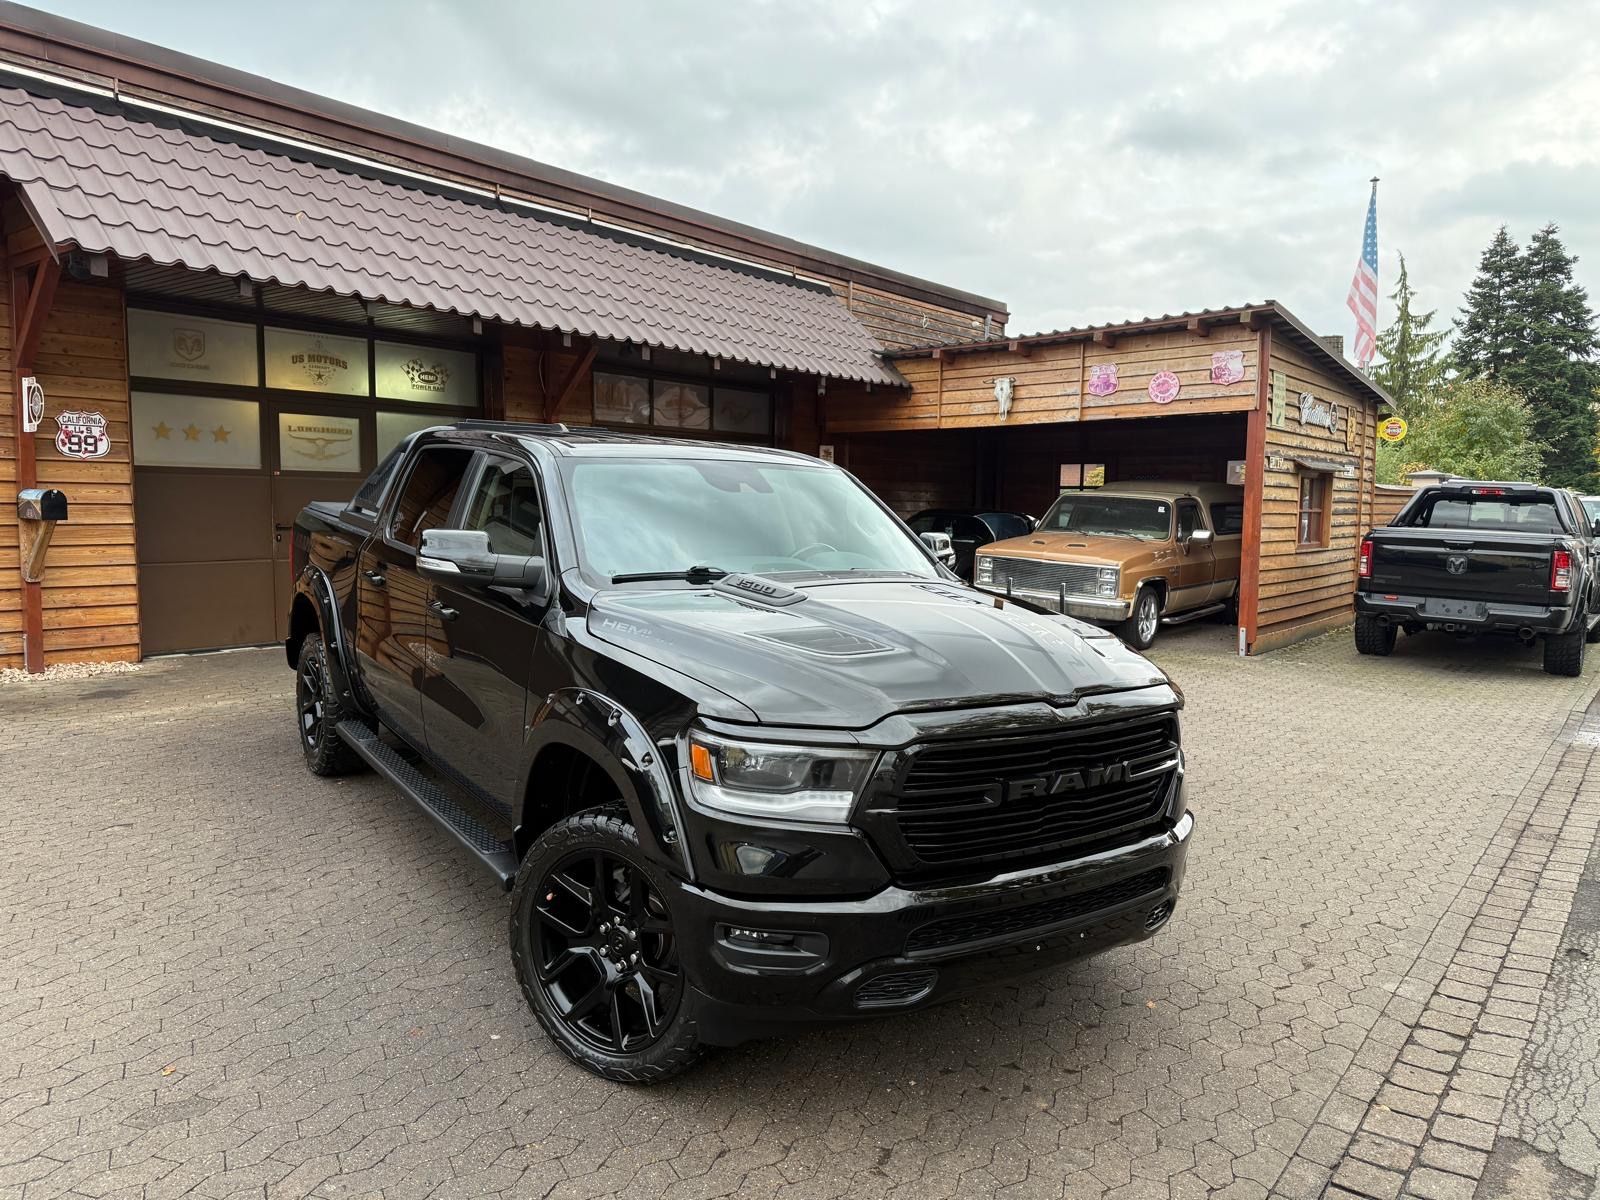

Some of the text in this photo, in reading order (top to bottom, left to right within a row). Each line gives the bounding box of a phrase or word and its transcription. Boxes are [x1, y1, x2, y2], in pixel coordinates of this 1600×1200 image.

[291, 353, 348, 370] US MOTORS
[61, 415, 103, 425] CALIFORNIA
[67, 434, 98, 454] 99
[736, 578, 777, 595] 1500
[1007, 762, 1124, 801] RAM
